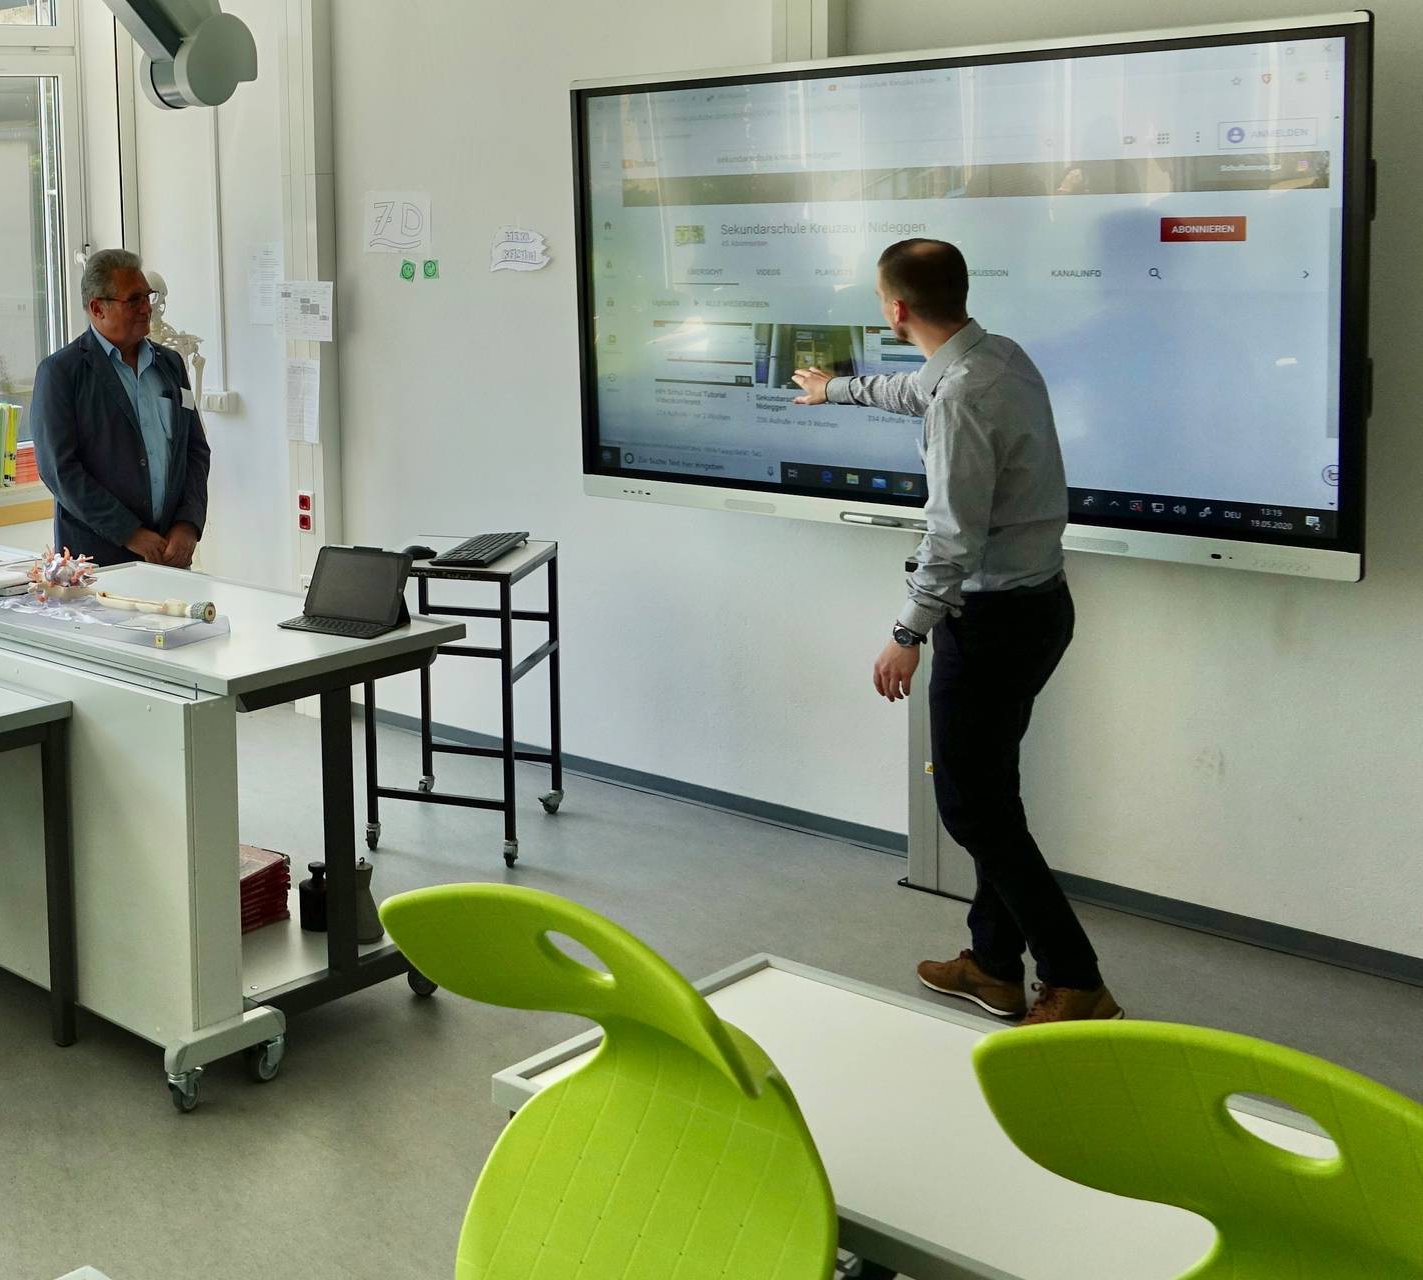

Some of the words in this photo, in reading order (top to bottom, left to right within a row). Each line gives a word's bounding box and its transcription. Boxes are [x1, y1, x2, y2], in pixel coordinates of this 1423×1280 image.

[720, 222, 807, 235] Sekundarschule
[809, 222, 857, 234] Kreuzau
[868, 221, 927, 236] Nideggen
[1171, 225, 1235, 234] ABONNIEREN
[966, 269, 1008, 277] SKUSSION
[1050, 269, 1102, 278] KANALINFO
[1224, 510, 1242, 519] DEU
[1261, 508, 1283, 516] 13:19
[1250, 519, 1293, 530] 19.05.2020
